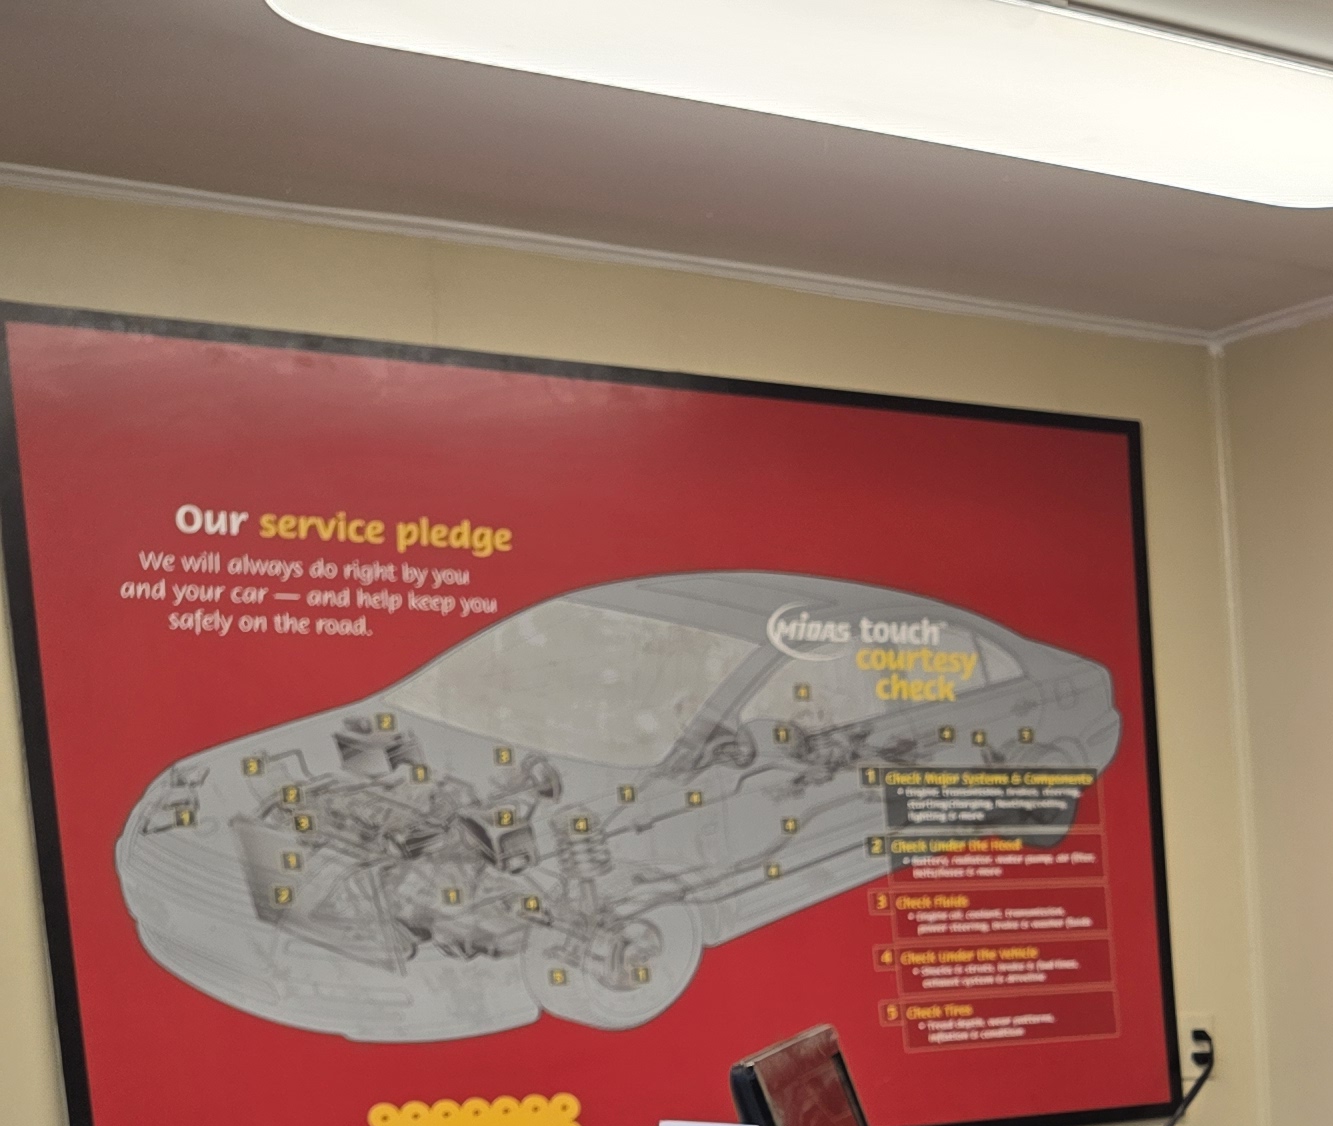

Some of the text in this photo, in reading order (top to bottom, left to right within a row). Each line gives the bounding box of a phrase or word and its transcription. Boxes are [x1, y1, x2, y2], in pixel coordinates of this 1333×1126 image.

[175, 504, 512, 557] Our service pledge
[139, 550, 470, 587] We will always do right by you
[120, 578, 497, 616] and your car and help keep you
[168, 609, 373, 636] safely on the road.
[856, 648, 978, 680] courtesy
[876, 674, 956, 702] check
[871, 839, 882, 854] 2
